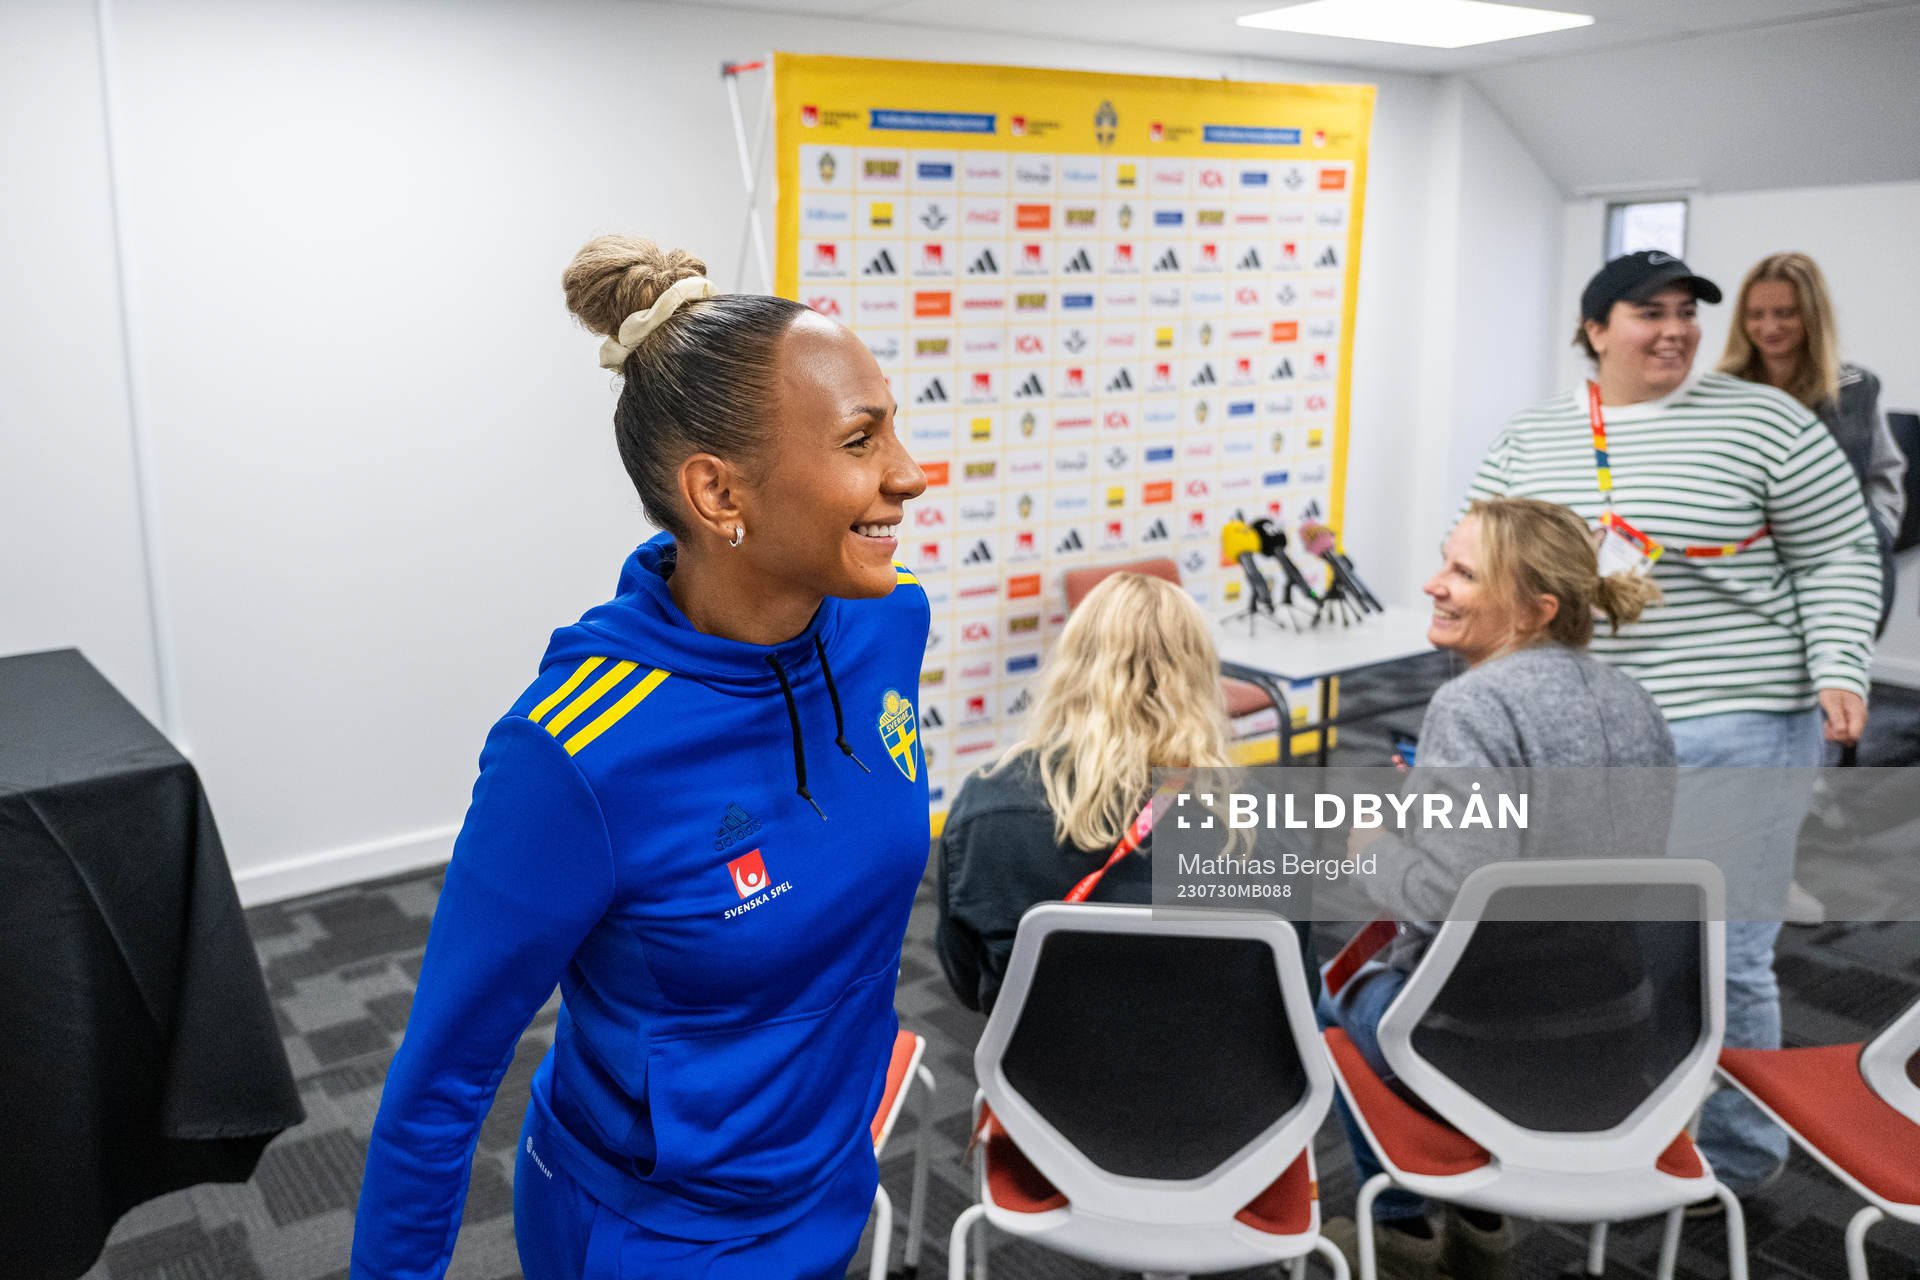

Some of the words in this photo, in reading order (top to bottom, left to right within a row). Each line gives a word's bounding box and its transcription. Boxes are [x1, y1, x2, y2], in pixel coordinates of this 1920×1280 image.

[1015, 336, 1043, 352] ICA
[1104, 412, 1130, 429] ICA
[915, 508, 945, 527] ICA
[962, 623, 991, 641] ICA
[724, 893, 770, 919] SVENSKA
[770, 880, 793, 899] SPEL
